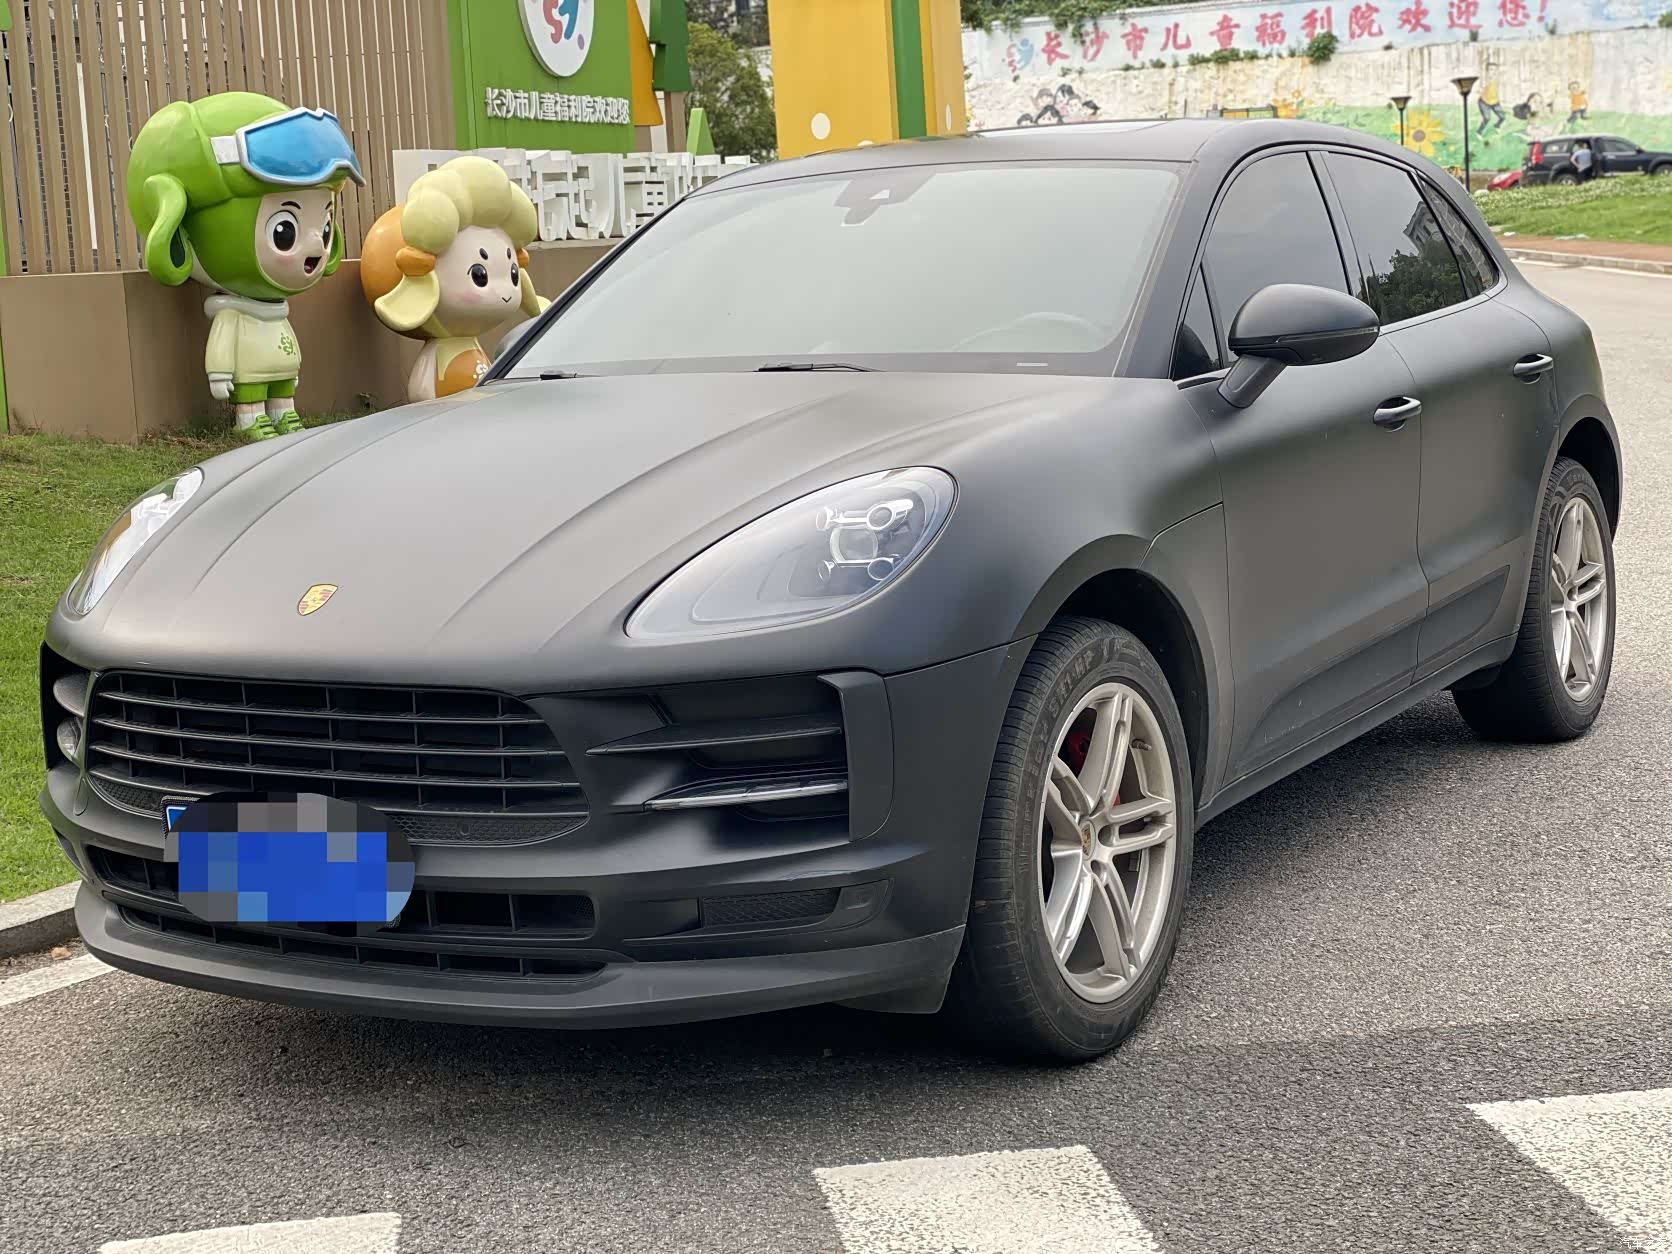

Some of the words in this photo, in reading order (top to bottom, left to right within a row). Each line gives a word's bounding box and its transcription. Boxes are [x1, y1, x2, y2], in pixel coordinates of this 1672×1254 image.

[485, 86, 631, 125] 长沙市儿童福利院欢迎您
